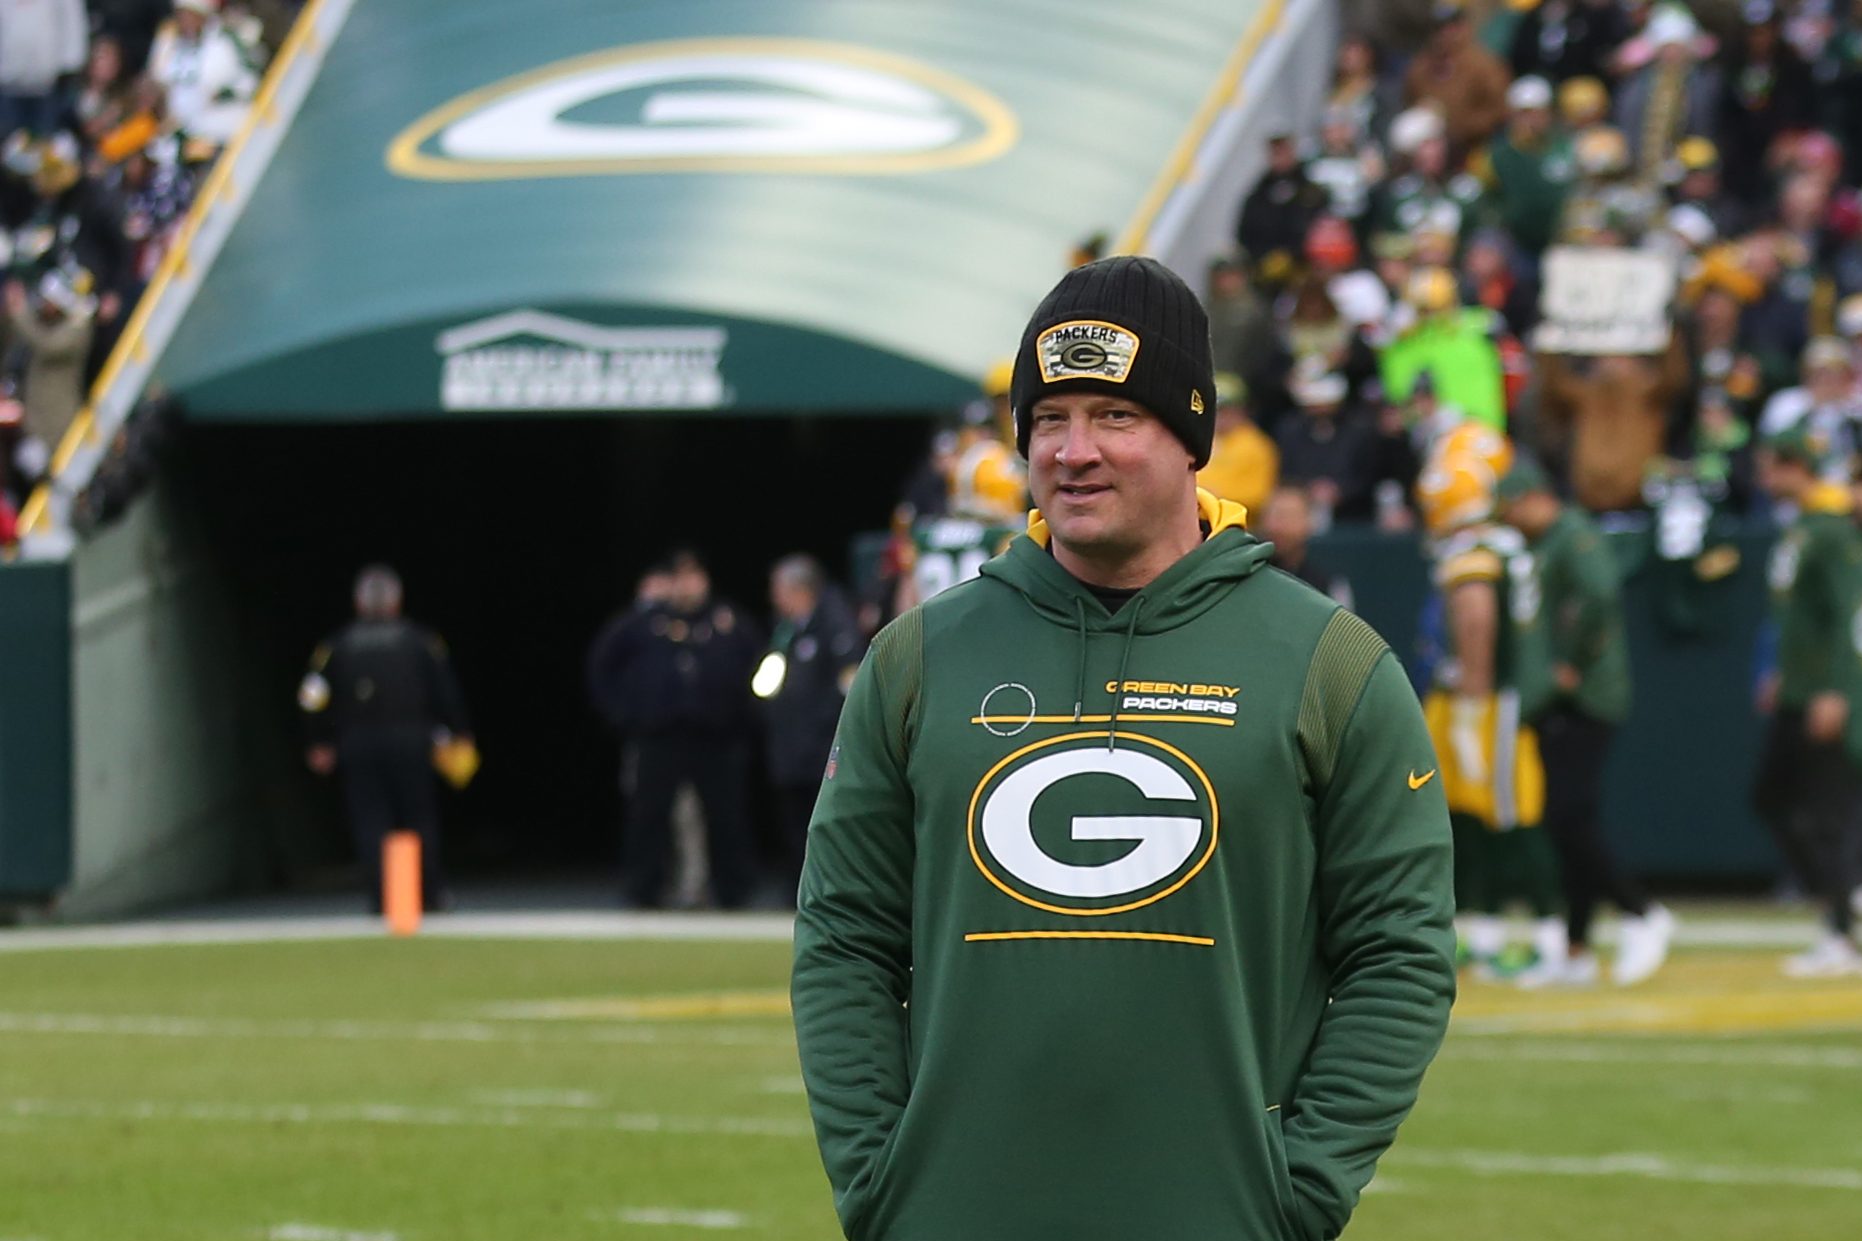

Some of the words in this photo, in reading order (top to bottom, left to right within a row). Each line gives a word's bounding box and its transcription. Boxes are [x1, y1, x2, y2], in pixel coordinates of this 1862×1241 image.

[1056, 326, 1118, 344] PACKERS
[1106, 681, 1187, 695] GREEN
[1189, 683, 1240, 698] BAY
[1122, 697, 1238, 715] PACKERS
[981, 747, 1202, 897] G
